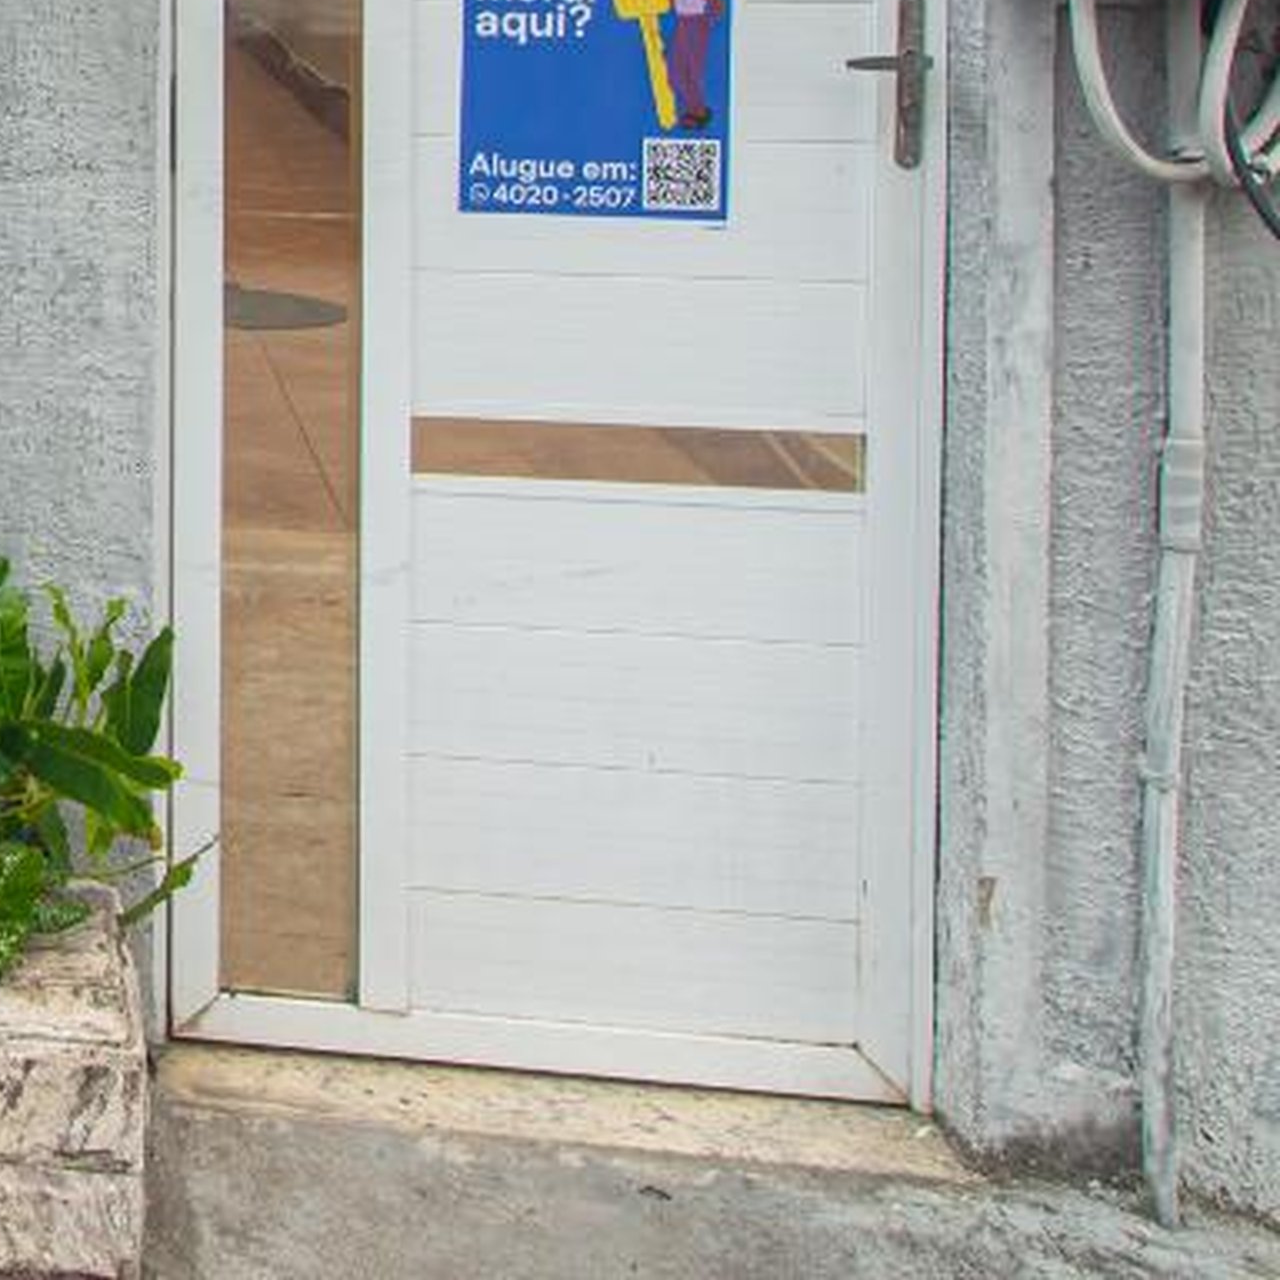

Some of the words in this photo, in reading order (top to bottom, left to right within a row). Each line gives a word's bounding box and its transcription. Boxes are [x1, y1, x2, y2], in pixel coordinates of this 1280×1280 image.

[475, 5, 592, 45] aqui?
[470, 152, 575, 183] Alugue
[582, 161, 638, 182] em:
